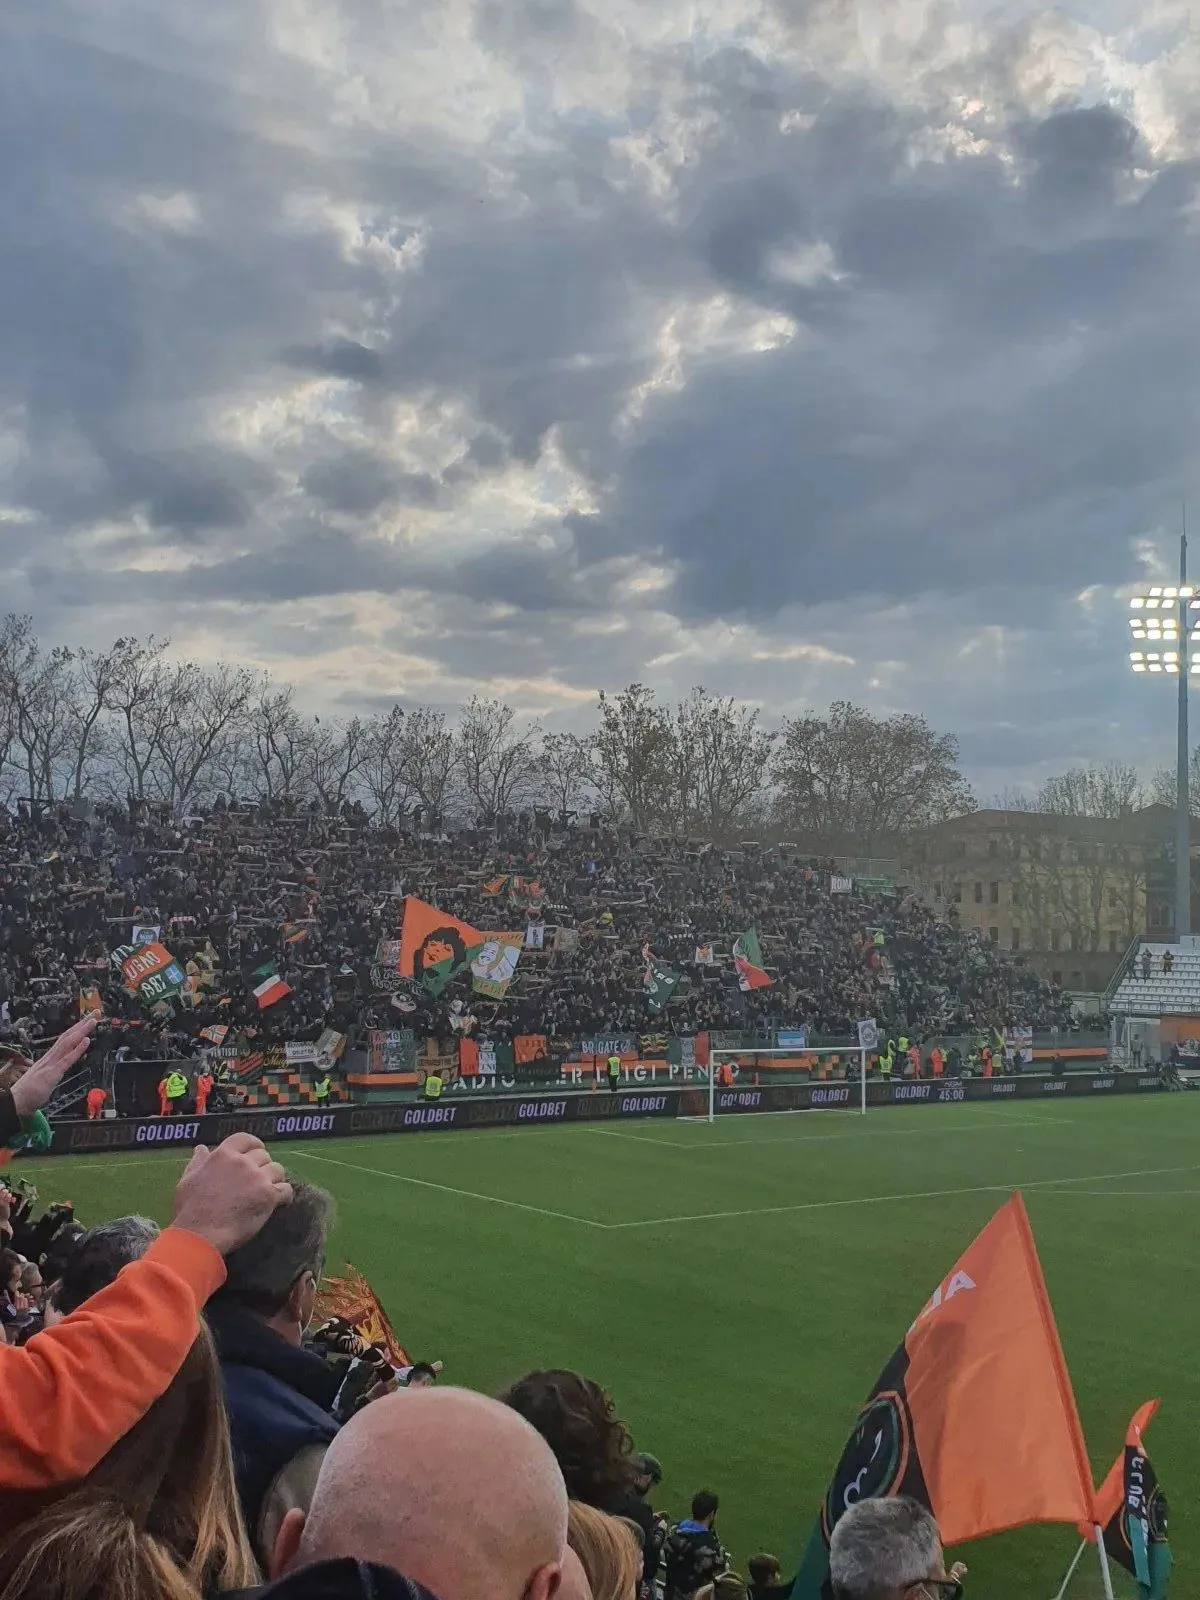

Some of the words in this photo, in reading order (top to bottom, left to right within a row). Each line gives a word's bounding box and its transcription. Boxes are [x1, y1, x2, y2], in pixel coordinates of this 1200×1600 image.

[141, 974, 167, 999] 1987
[597, 1064, 656, 1083] LIGI
[811, 1089, 850, 1102] GOLDBET
[895, 1085, 931, 1099] GOLDBET
[992, 1084, 1016, 1093] GOLDBET
[518, 1101, 567, 1118] GOLDBET
[622, 1096, 667, 1112] GOLDBET
[276, 1115, 336, 1133] GOLDBET
[403, 1107, 457, 1125] GOLDBET
[135, 1122, 201, 1142] GOLDBET
